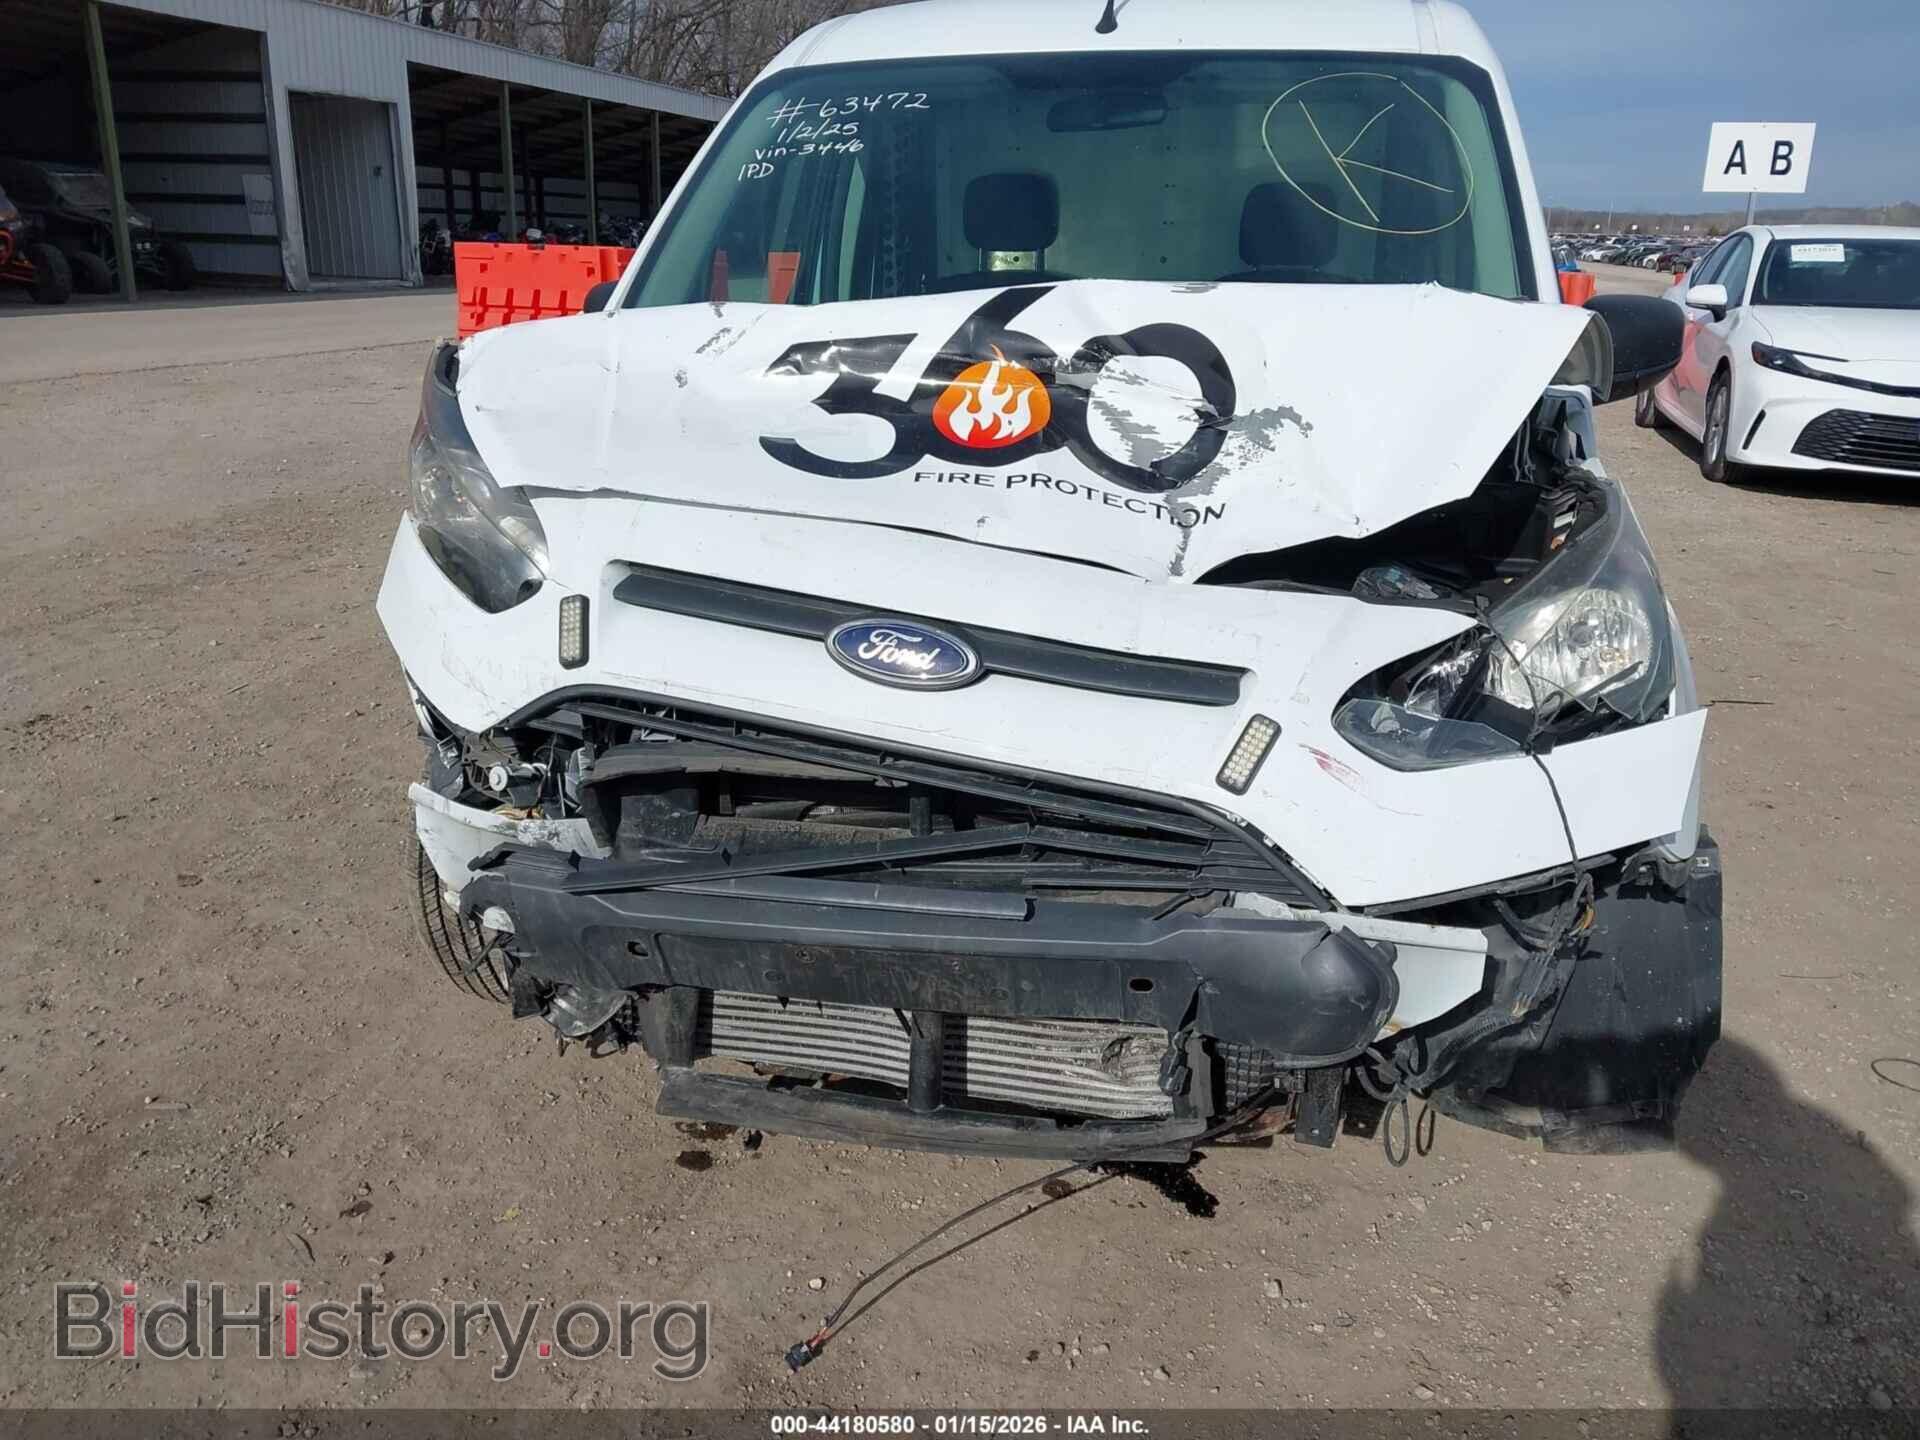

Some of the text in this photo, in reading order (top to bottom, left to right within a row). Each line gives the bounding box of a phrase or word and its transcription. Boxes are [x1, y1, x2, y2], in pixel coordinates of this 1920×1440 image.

[777, 120, 860, 143] 1/2/25
[1723, 139, 1795, 176] A B
[758, 284, 1237, 494] 360
[913, 471, 996, 488] FIRE
[857, 628, 942, 670] Ford
